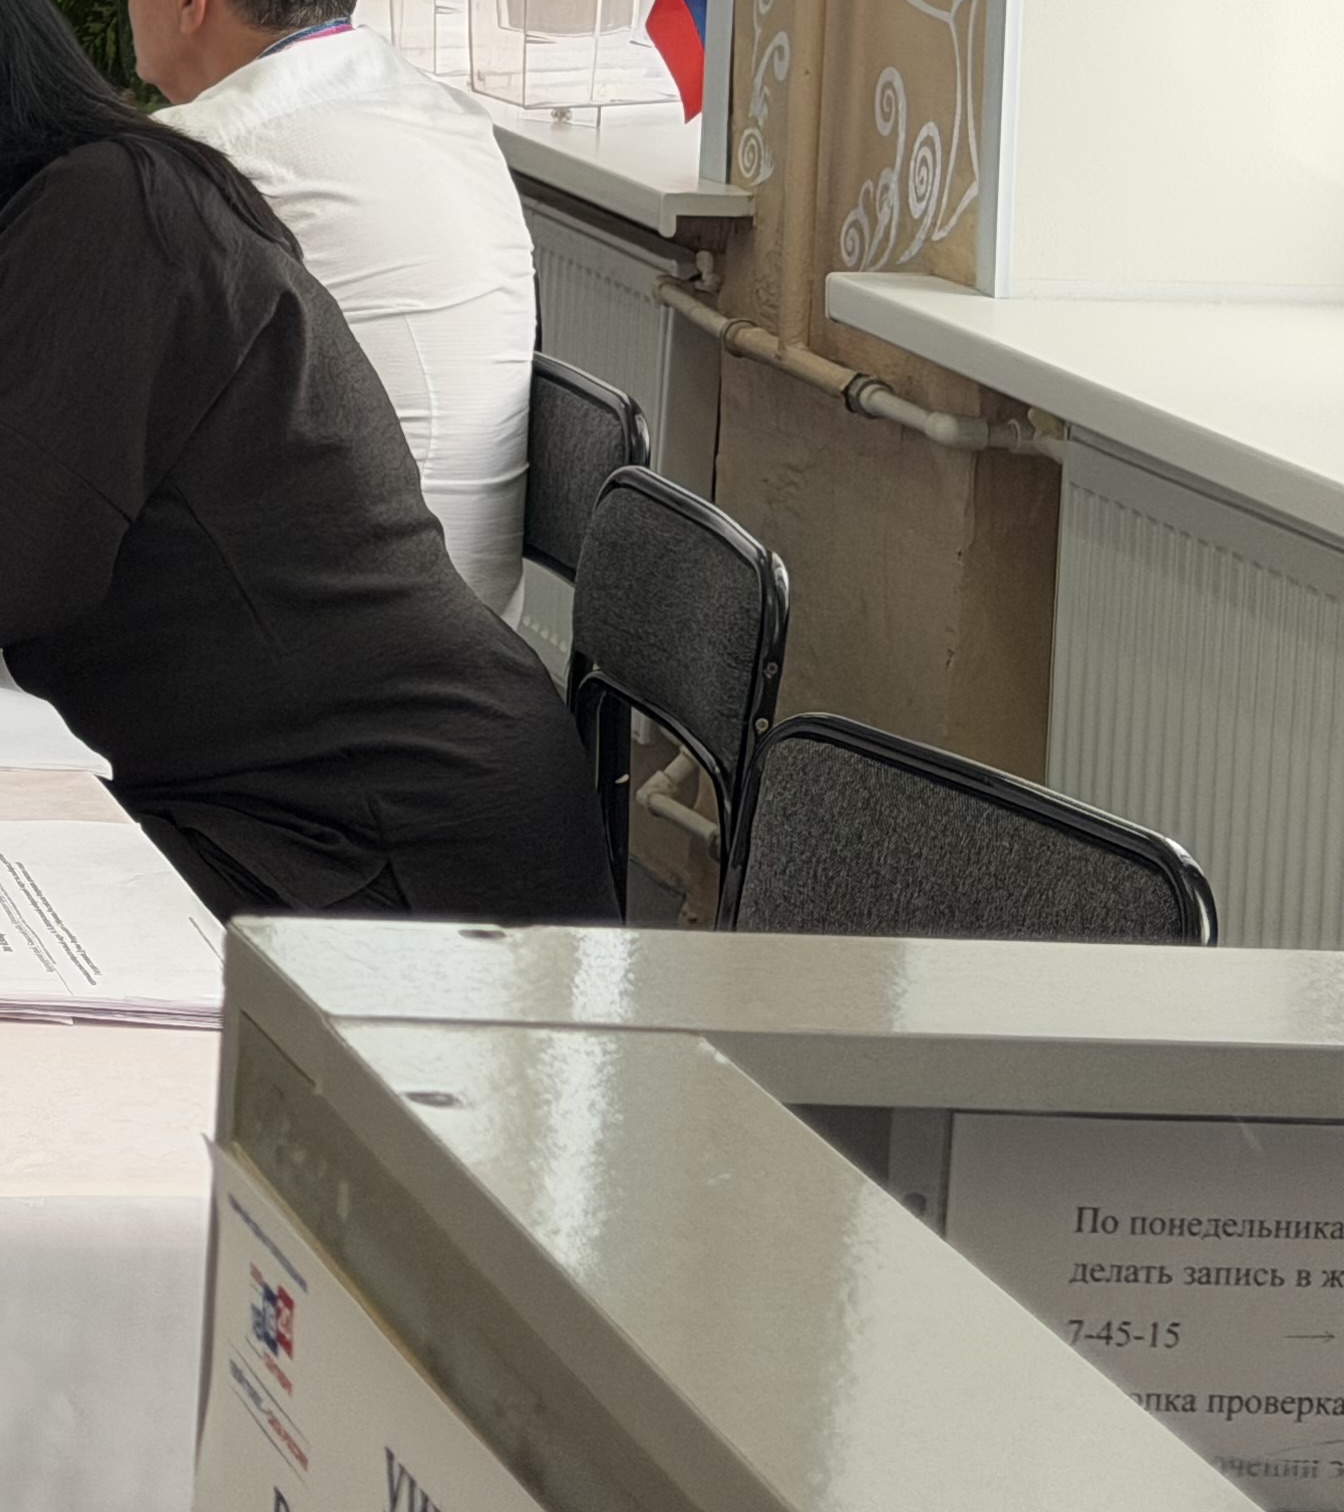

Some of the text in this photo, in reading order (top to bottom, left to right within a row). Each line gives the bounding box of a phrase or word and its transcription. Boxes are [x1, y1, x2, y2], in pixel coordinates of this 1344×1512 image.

[1074, 1206, 1119, 1234] По
[1069, 1262, 1344, 1288] делать запись в ж
[1067, 1319, 1182, 1349] 7-45-15
